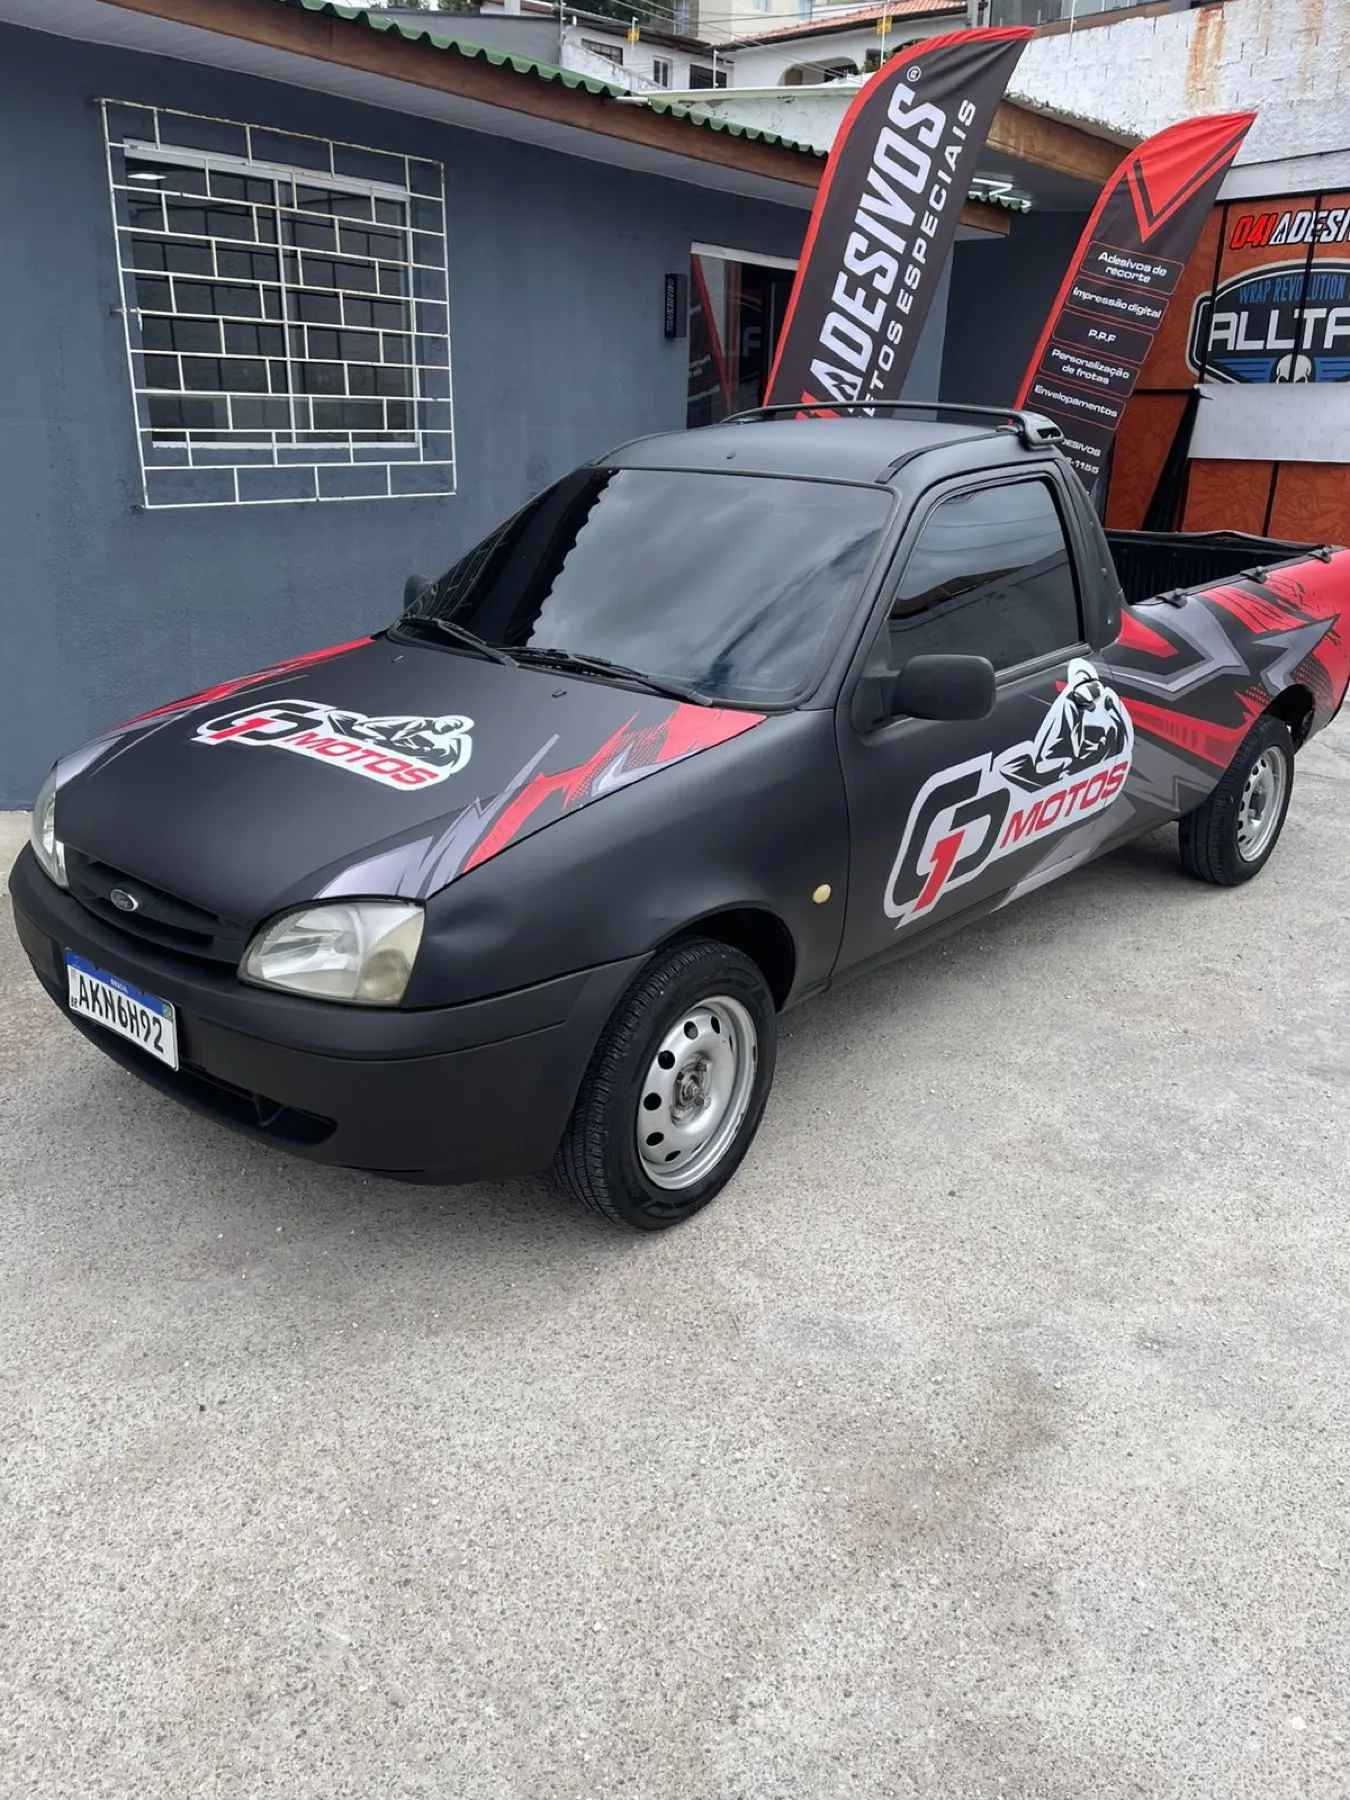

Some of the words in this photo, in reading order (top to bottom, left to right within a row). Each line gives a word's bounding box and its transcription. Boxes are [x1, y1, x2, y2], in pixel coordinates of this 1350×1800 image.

[896, 99, 977, 315] ESPECIAIS
[1230, 208, 1350, 250] 041ADESI
[1097, 251, 1152, 273] Adesivos
[1152, 265, 1168, 277] de
[1105, 266, 1151, 283] recorte
[1072, 286, 1128, 310] Impressão
[1127, 303, 1162, 319] digital
[1240, 280, 1271, 304] WRAP
[1273, 274, 1347, 302] REVOUTION
[1051, 348, 1130, 379] Personalização
[1061, 364, 1075, 375] de
[1075, 368, 1110, 385] frotas
[1034, 384, 1118, 418] Envelopamentos
[282, 731, 440, 786] MOTOS
[999, 760, 1129, 849] MOTOS
[79, 974, 164, 1054] AKN6H92
